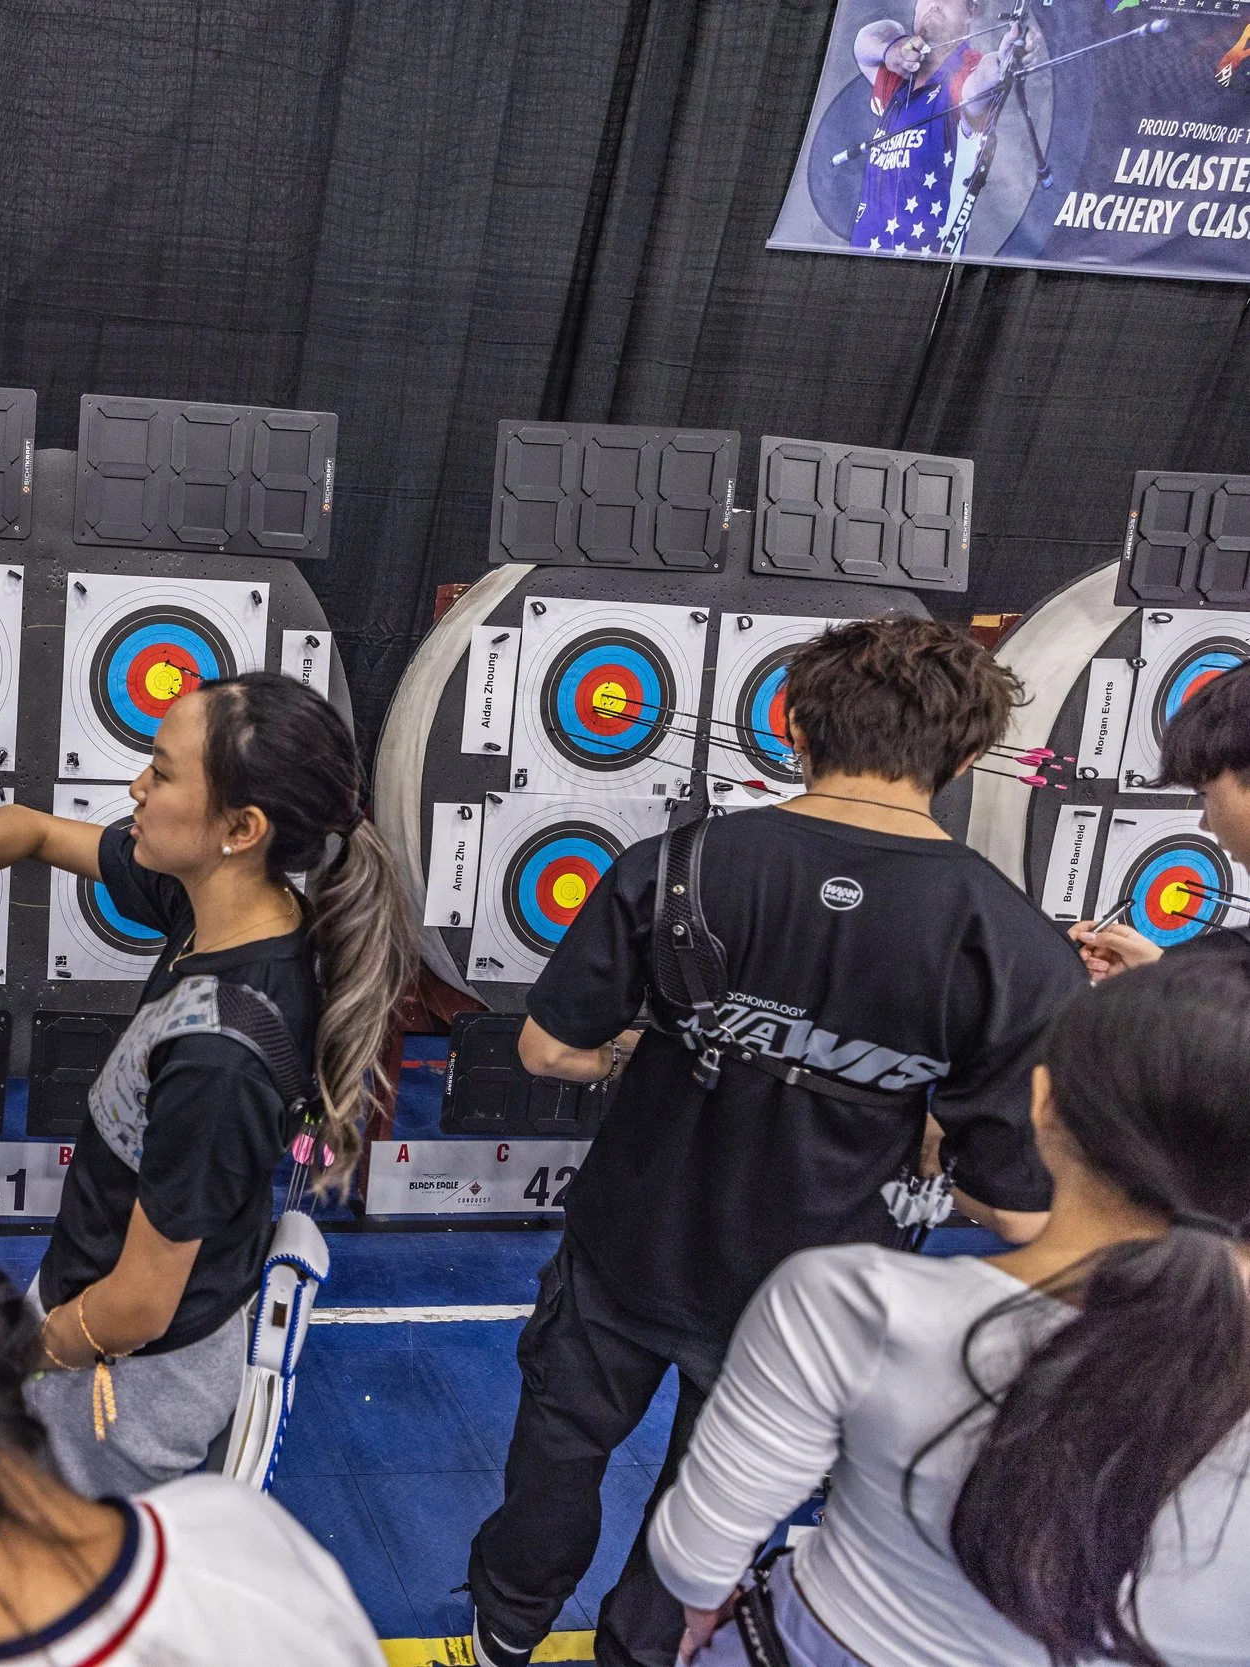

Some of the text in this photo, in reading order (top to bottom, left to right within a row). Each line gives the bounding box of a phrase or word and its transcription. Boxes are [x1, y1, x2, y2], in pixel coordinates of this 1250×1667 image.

[1138, 118, 1179, 137] PROUD
[1179, 121, 1227, 143] SPONSOR
[1227, 127, 1243, 144] OF
[1114, 148, 1250, 193] LANCASTE
[1053, 191, 1250, 239] ARCHERY CLAS
[302, 658, 312, 685] Eliza
[481, 653, 499, 729] Aidan Zhoung
[1094, 681, 1114, 755] Morgan Everts
[452, 841, 465, 891] Anne Zhu
[1063, 824, 1086, 902] Braedy Banfield
[59, 1146, 73, 1166] B
[396, 1143, 510, 1163] A C
[409, 1181, 459, 1190] BLACK EAGLE
[523, 1166, 579, 1207] 42
